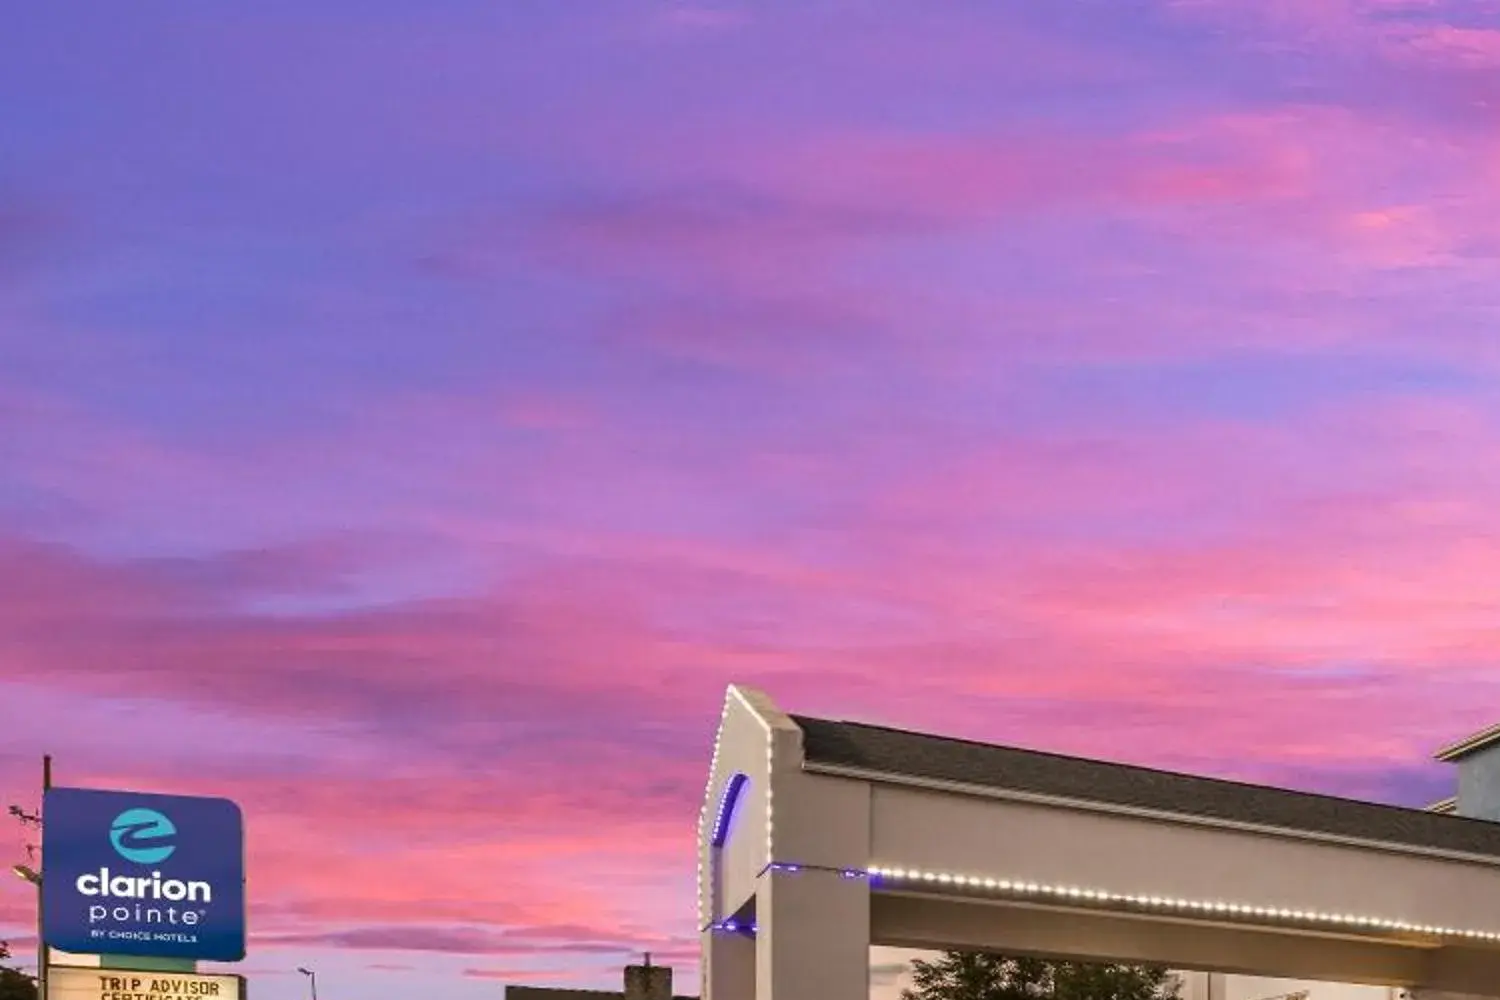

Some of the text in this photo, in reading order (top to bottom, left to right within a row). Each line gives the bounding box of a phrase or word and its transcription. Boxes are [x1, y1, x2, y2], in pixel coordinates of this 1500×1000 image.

[76, 867, 212, 902] clarion
[89, 903, 198, 925] pointe
[91, 929, 198, 943] BY CHOICE HOTELS
[99, 976, 219, 996] TRIP ADVISOR
